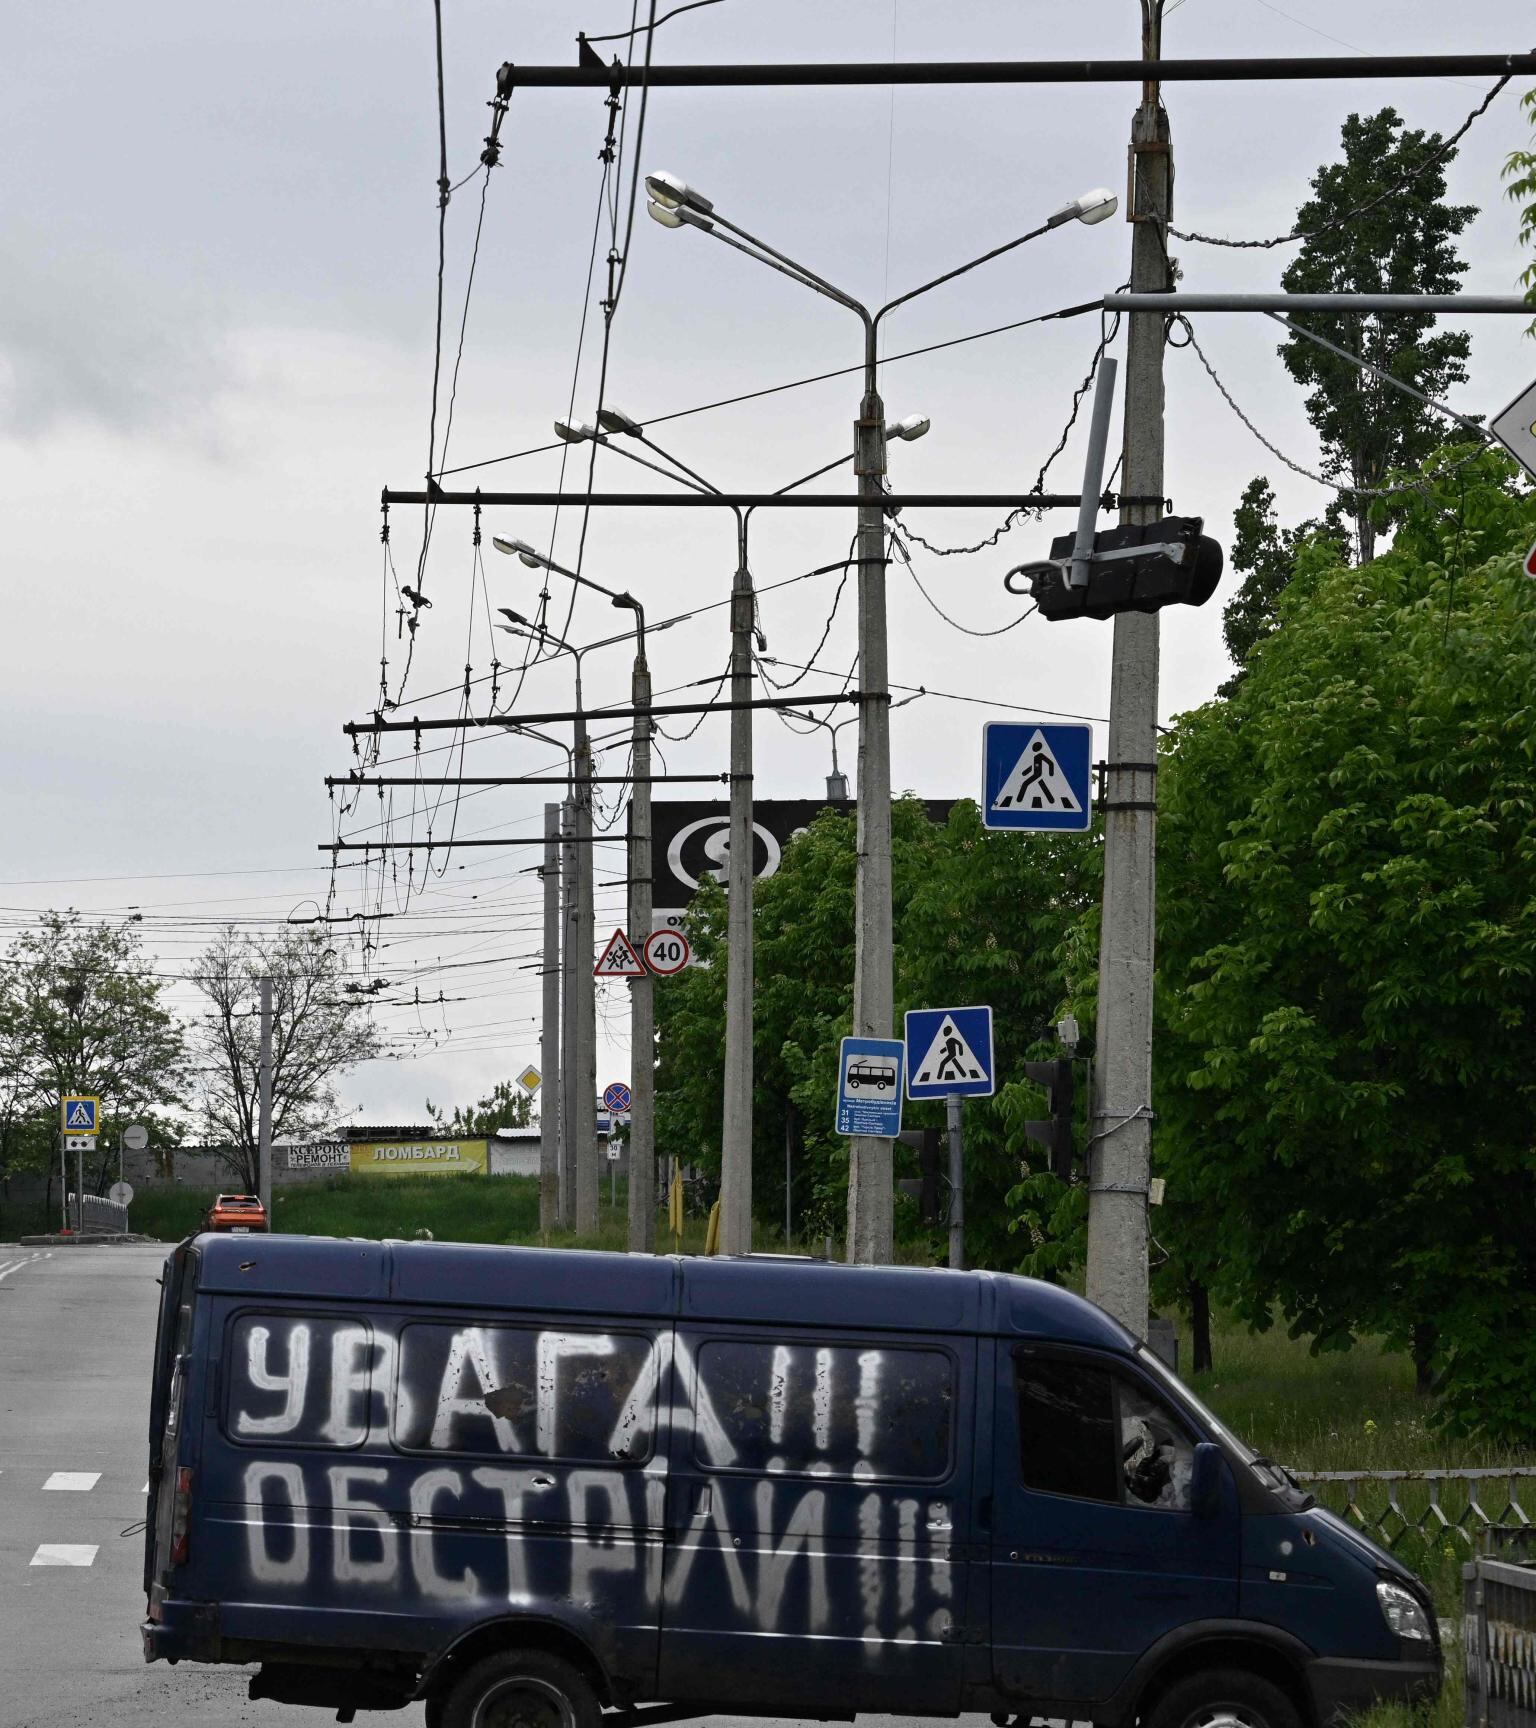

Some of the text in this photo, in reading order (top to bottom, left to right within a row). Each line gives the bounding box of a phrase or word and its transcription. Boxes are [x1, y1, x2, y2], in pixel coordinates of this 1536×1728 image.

[653, 942, 681, 962] 40
[840, 1124, 850, 1132] 42
[289, 1144, 349, 1155] КСЕРОКС
[373, 1145, 461, 1161] ЛОМБАРД
[296, 1153, 344, 1164] РЕМОНТ
